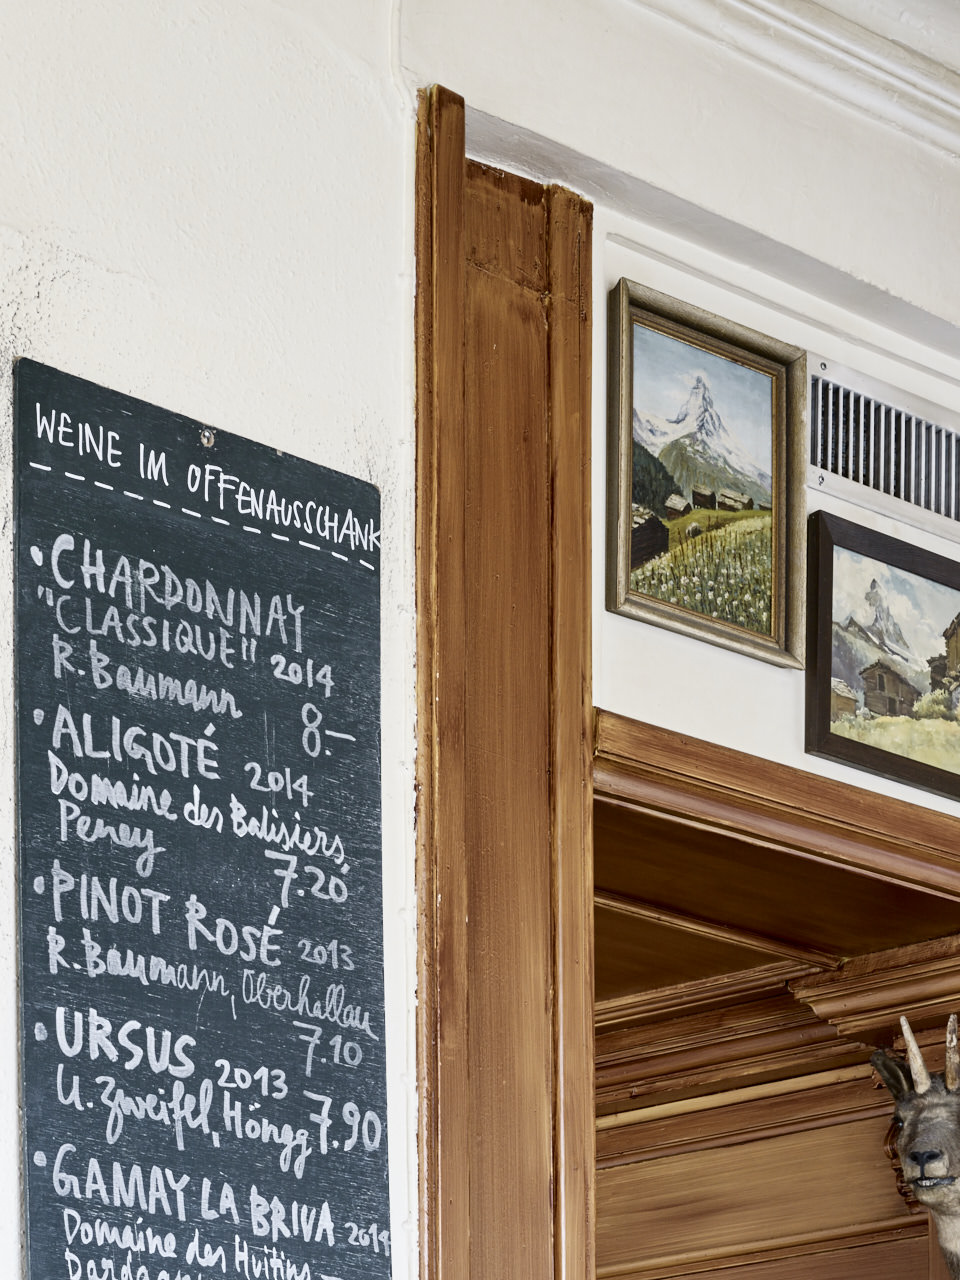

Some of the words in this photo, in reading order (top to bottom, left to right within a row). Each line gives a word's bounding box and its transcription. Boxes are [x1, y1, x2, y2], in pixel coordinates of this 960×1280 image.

[35, 402, 122, 467] WEINE
[139, 443, 169, 487] IM
[186, 463, 381, 552] OFFENAUSSCHANK
[52, 533, 305, 652] CHARDONNAY
[270, 653, 335, 698] 2014
[48, 750, 178, 821] Domaine
[183, 784, 223, 834] des
[52, 703, 221, 780] ALIGOTÉ
[244, 761, 315, 807] 2014
[52, 859, 171, 935] PINOT
[185, 895, 284, 966] ROSÉ
[297, 938, 355, 971] 2013
[265, 849, 349, 908] 7.20
[55, 1006, 197, 1078] URSUS
[214, 1058, 289, 1099] 2013
[292, 1020, 363, 1077] 7.10
[302, 1088, 382, 1155] 7.90
[52, 1143, 191, 1221] GAMAY
[200, 1177, 240, 1225] LA
[249, 1184, 335, 1246] BRIVA
[63, 1208, 178, 1259] Domaine
[185, 1228, 227, 1273] des
